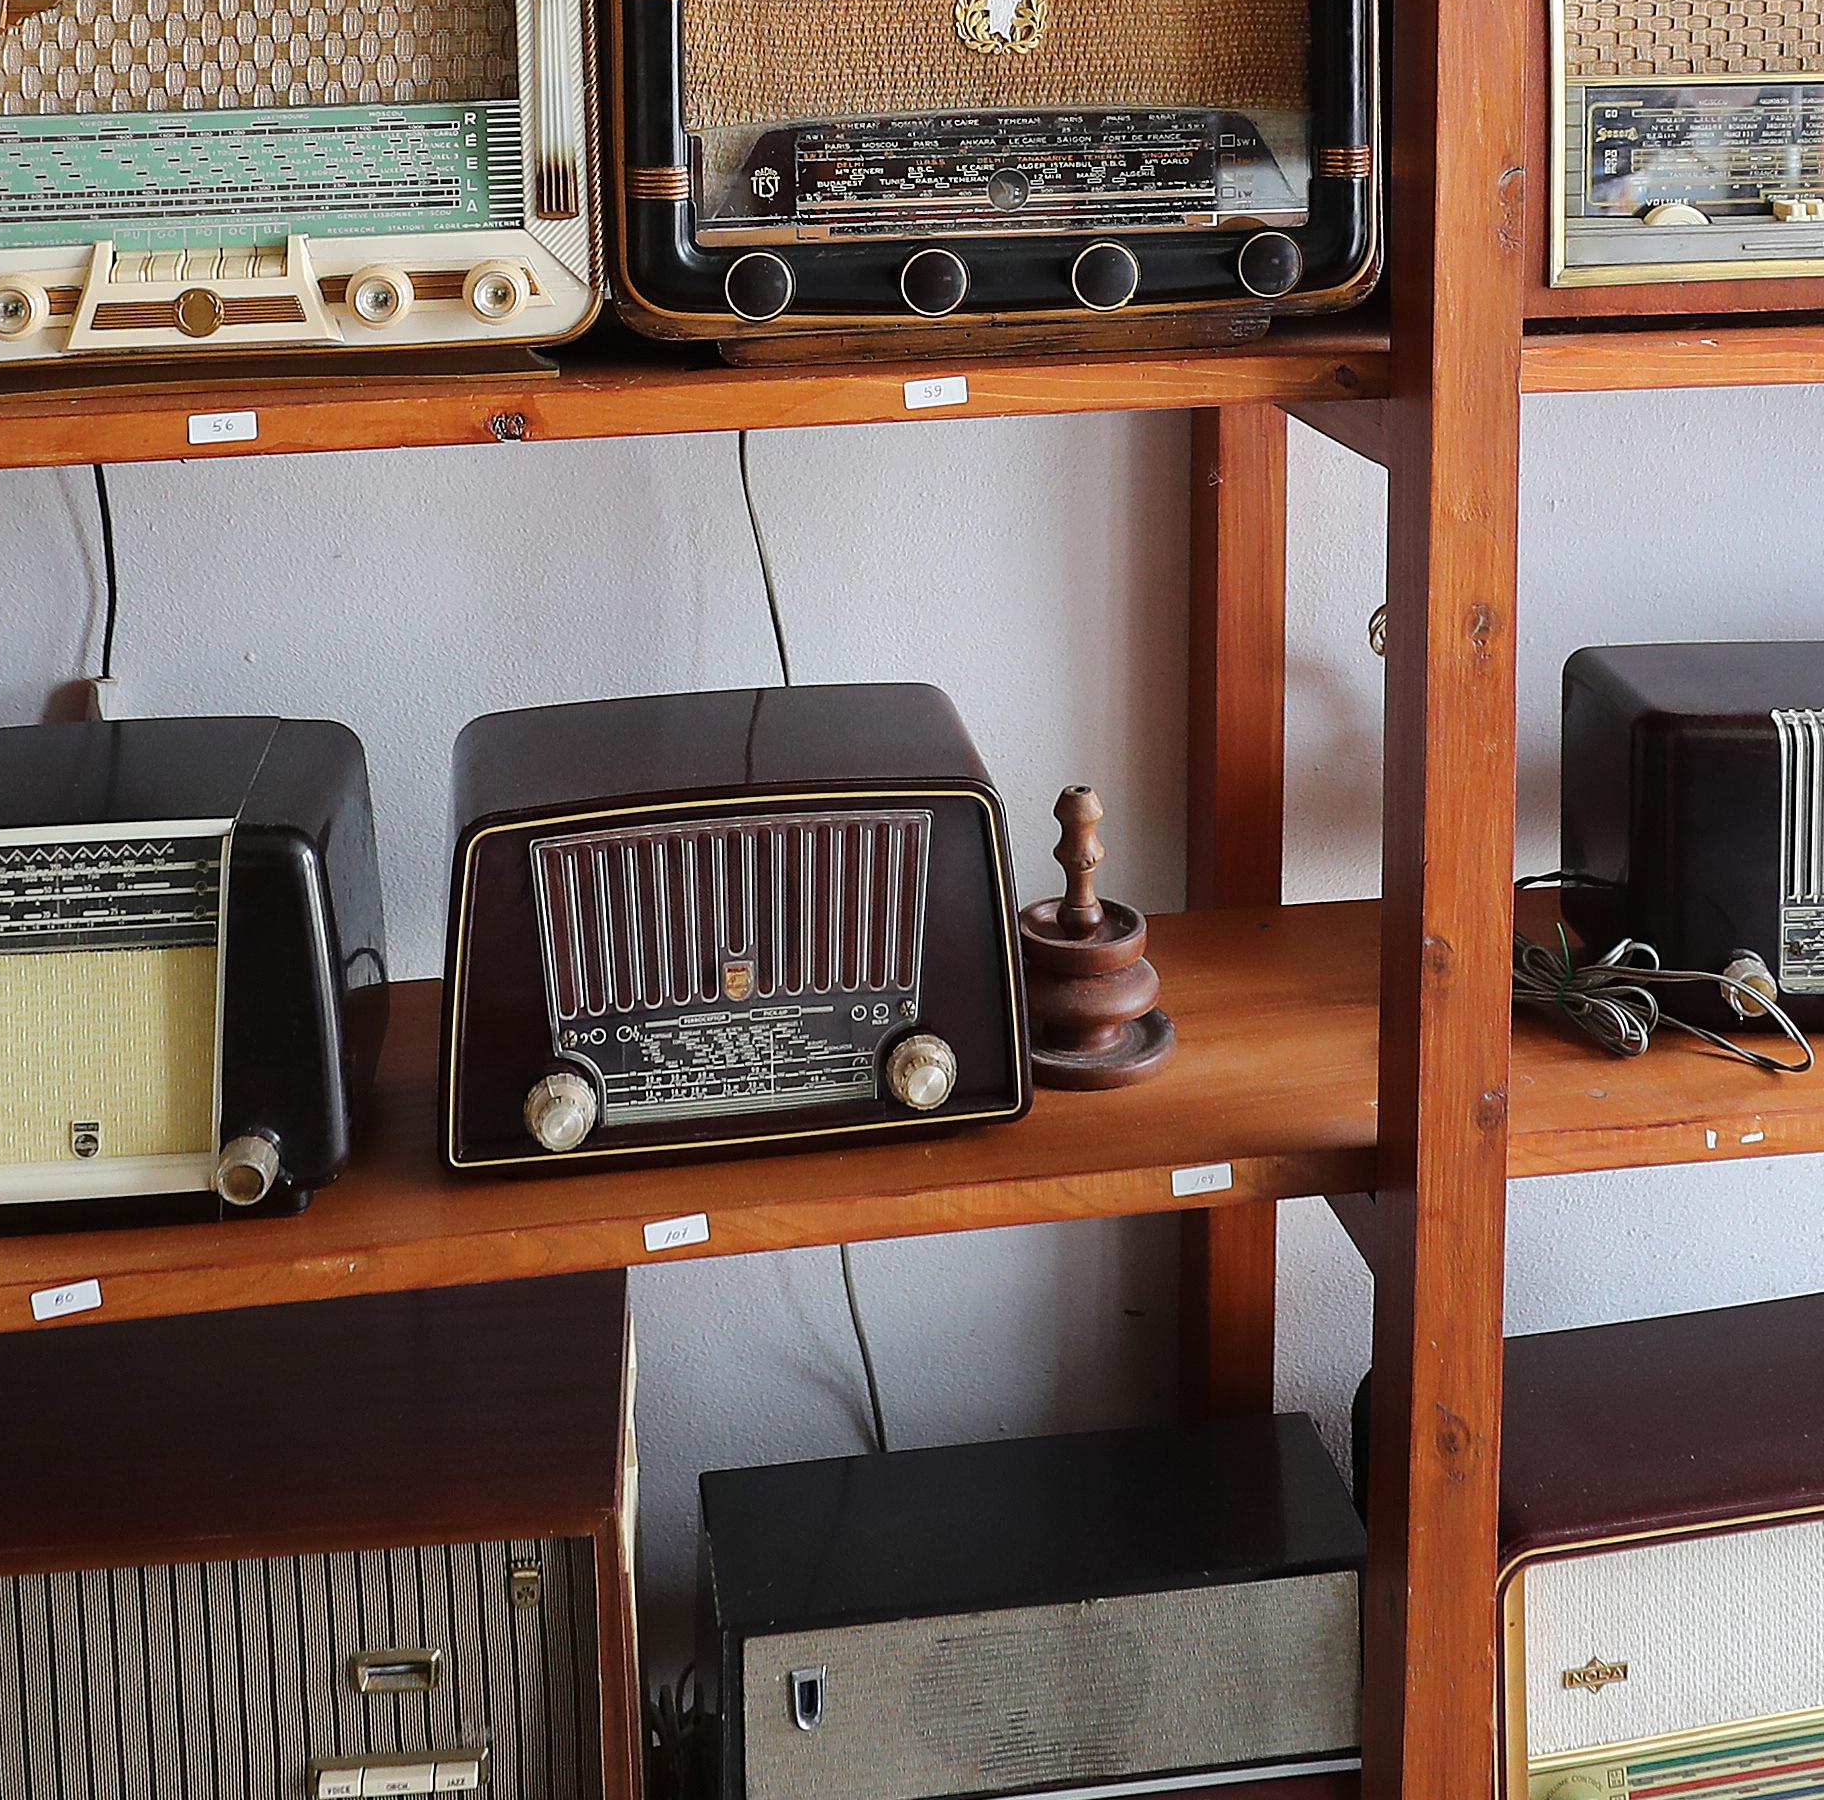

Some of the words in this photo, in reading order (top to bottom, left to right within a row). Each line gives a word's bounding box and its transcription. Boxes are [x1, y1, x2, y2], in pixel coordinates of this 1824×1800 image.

[368, 110, 404, 118] MOSCOU
[997, 116, 1040, 126] TEHERAN
[1605, 110, 1618, 118] GO
[824, 141, 850, 150] PARIS
[862, 140, 898, 149] MOSCOU
[913, 140, 939, 148] PARIS
[959, 138, 996, 147] ANKARA
[1009, 136, 1020, 145] LE
[1021, 136, 1047, 145] CAIRE
[1056, 135, 1092, 144] SAIGON
[1103, 134, 1126, 142] FORT
[1131, 133, 1144, 142] DE
[1146, 133, 1182, 141] FRANCE
[1595, 126, 1639, 143] Sonora
[836, 161, 865, 169] DELHI
[976, 157, 1005, 165] DELHI
[1017, 154, 1074, 162] TANANARIVE
[1083, 152, 1125, 161] TEHERAN
[1141, 151, 1194, 160] SINGAPOUR
[851, 167, 884, 176] CENERI
[968, 164, 995, 172] CAIRE
[1016, 163, 1046, 171] ALGER
[1050, 161, 1093, 170] ISTANBUL
[1160, 158, 1190, 166] CARLO
[750, 175, 781, 199] TEST
[817, 179, 864, 188] BUDAPEST
[879, 178, 906, 186] TUNIS
[915, 176, 944, 185] RABAT
[948, 175, 989, 184] TEHERAN
[1645, 198, 1690, 207] VOLUME
[157, 230, 177, 239] GO
[195, 228, 213, 237] PO
[228, 227, 247, 236] OC
[327, 226, 376, 234] RECHERCHE
[388, 224, 425, 232] STATIONS
[434, 222, 463, 230] CADRE
[923, 384, 944, 399] 59
[213, 419, 235, 433] 56
[664, 1227, 689, 1245] 107
[327, 1785, 352, 1795] VOICE
[446, 1776, 466, 1788] JAZZ
